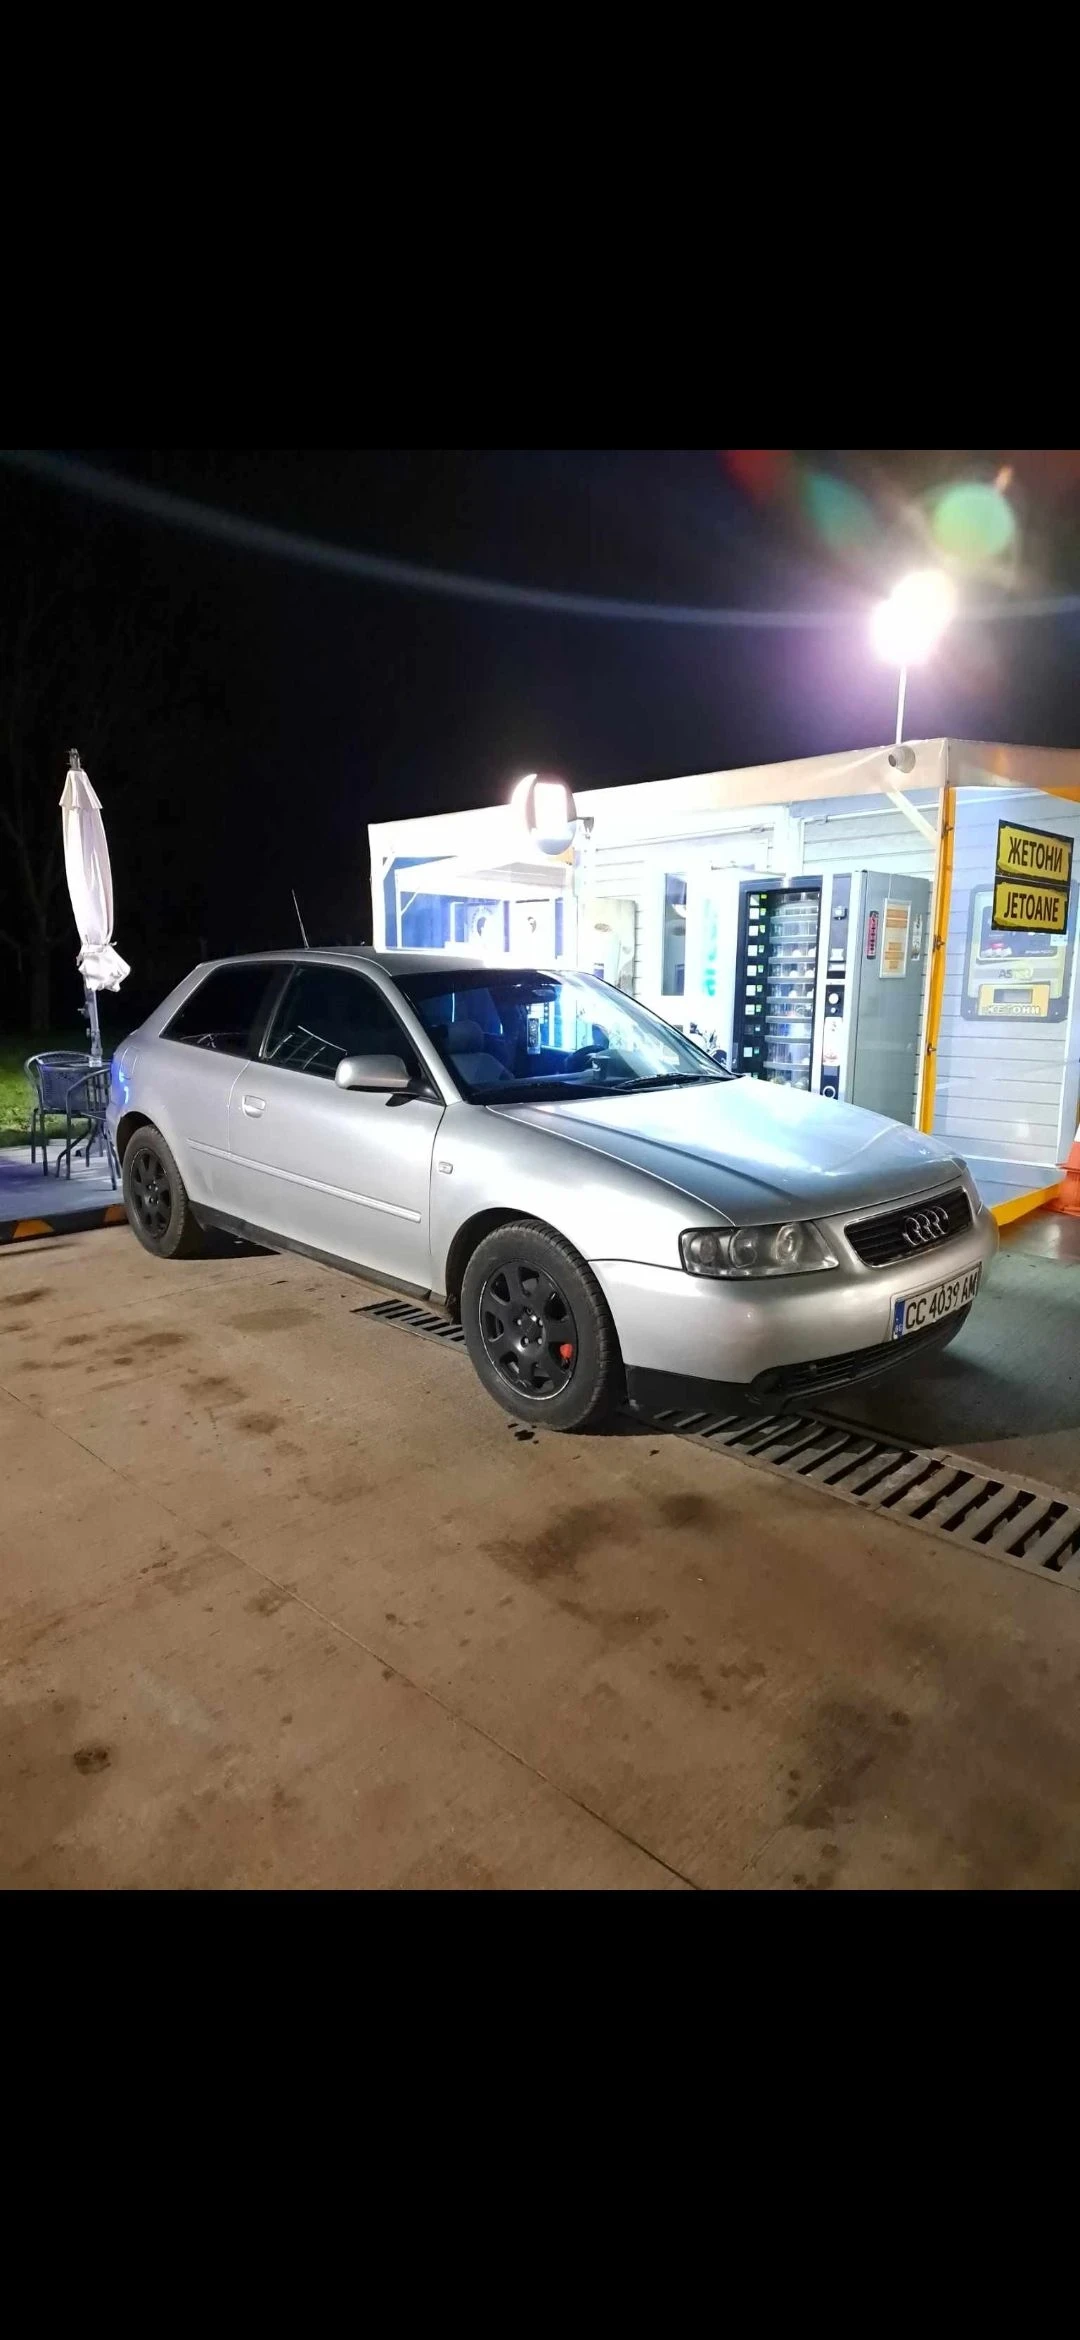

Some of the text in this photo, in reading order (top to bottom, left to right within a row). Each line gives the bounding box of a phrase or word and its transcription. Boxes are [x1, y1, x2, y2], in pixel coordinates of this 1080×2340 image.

[1007, 836, 1063, 873] ЖЕТОНИ
[1003, 892, 1060, 922] JETOANE
[929, 1281, 960, 1319] 4039
